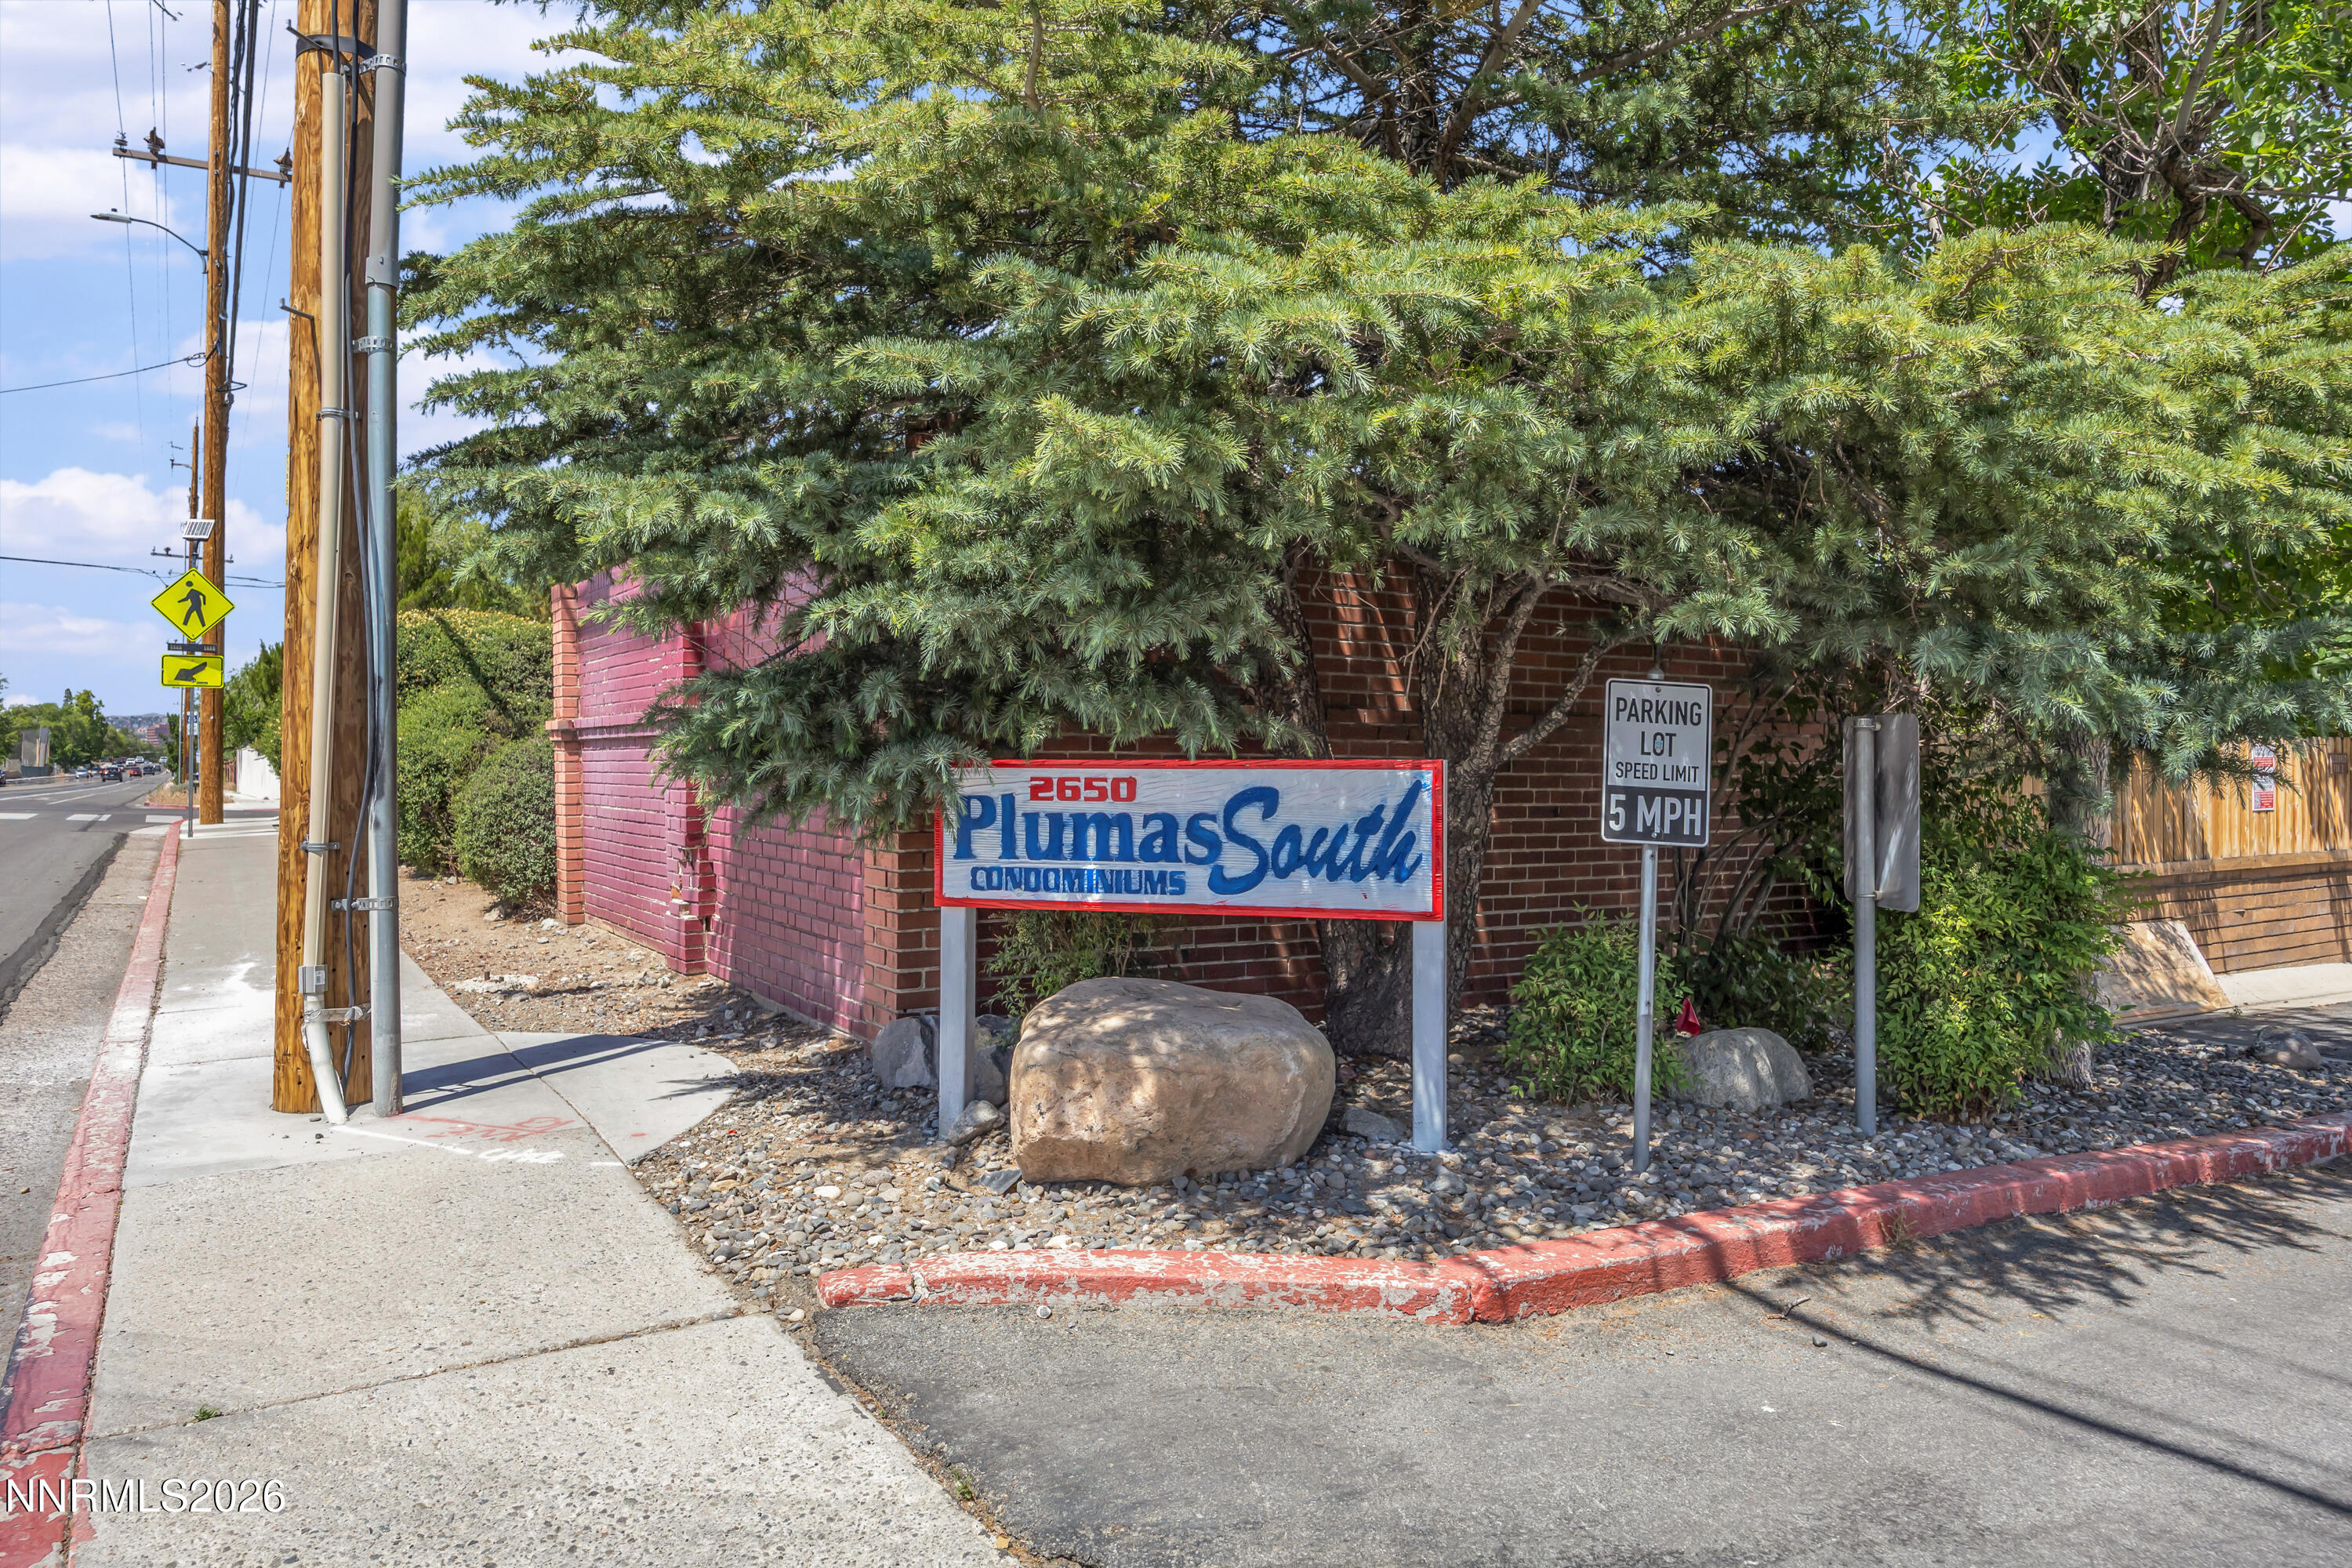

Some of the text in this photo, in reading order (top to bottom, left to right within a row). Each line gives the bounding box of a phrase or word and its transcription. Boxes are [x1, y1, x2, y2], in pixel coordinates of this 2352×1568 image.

[1615, 696, 1702, 726] PARKING
[1640, 731, 1677, 757] LOT
[1615, 761, 1700, 782] SPEED LIMIT
[1029, 776, 1138, 803] 2650
[1609, 793, 1702, 836] 5 MPH
[953, 779, 1423, 895] Plumas South
[971, 866, 1186, 895] CONDOMINIUMS
